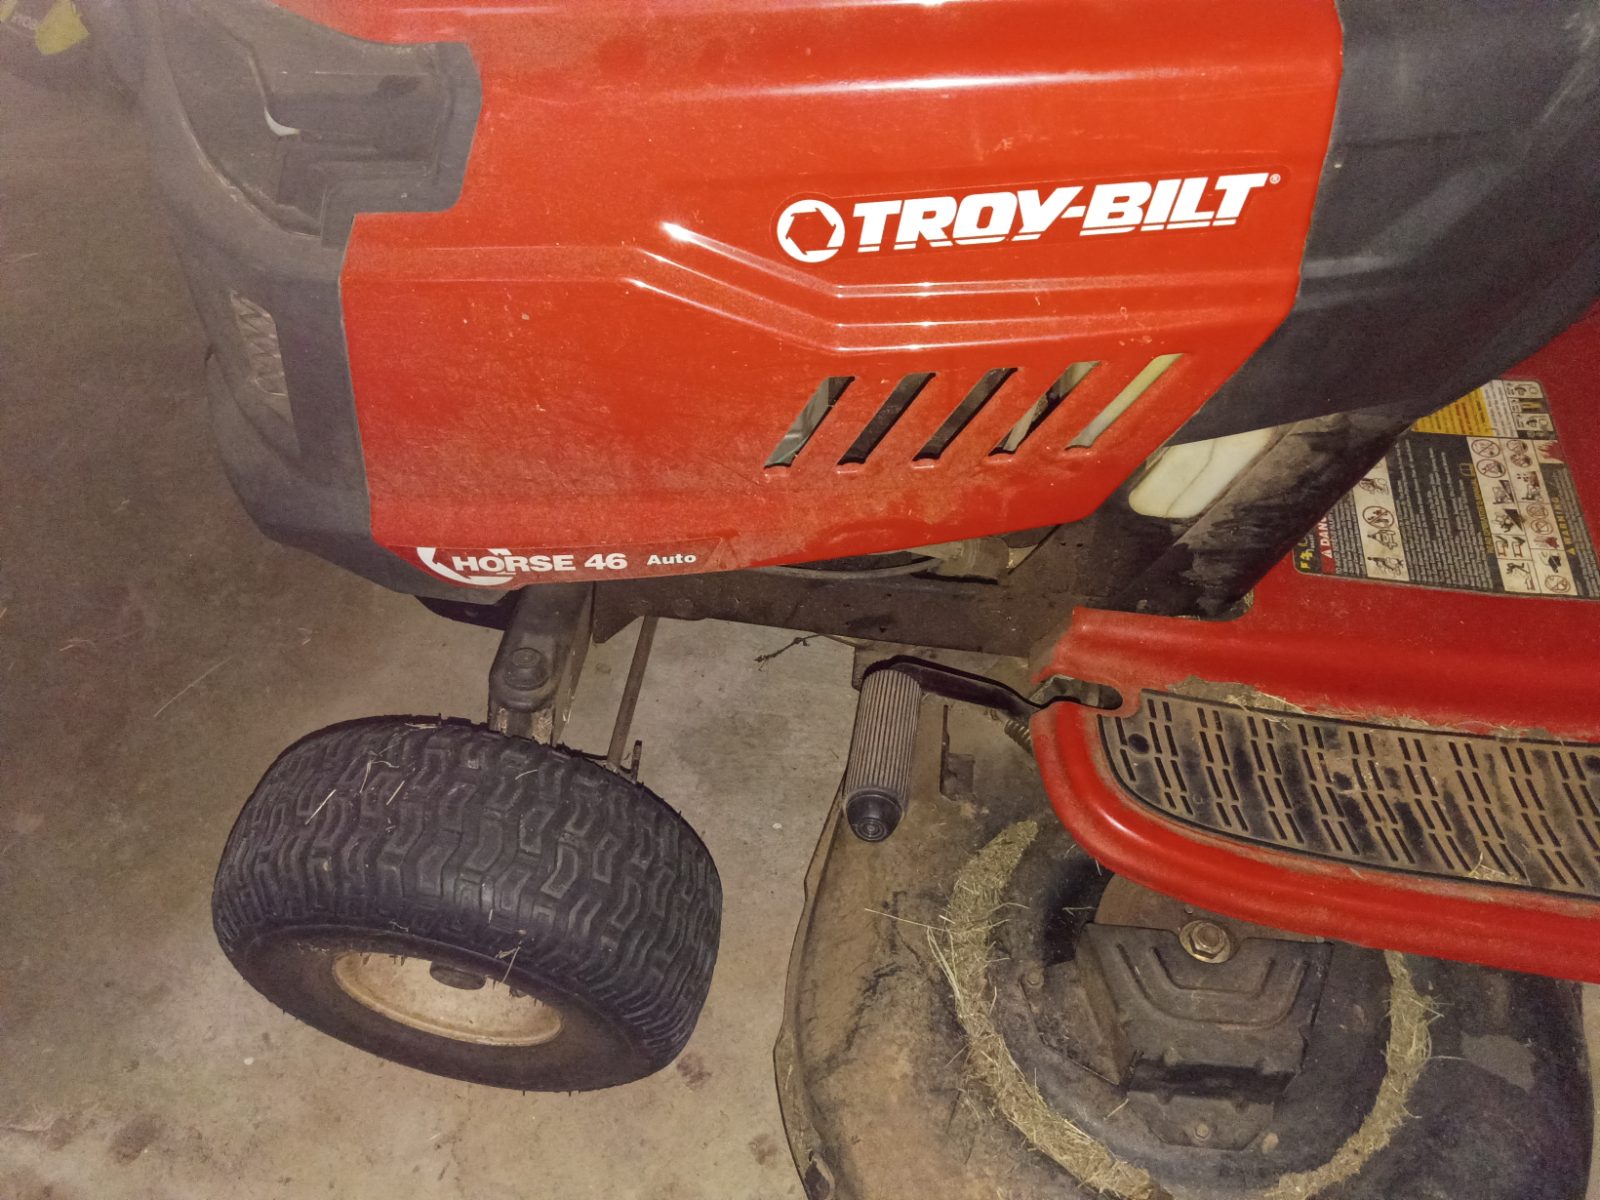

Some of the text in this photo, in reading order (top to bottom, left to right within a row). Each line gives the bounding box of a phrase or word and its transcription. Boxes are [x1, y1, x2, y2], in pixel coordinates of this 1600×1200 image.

[853, 172, 1269, 253] TROY-BILT
[452, 552, 697, 573] HORSE 46 Auto
